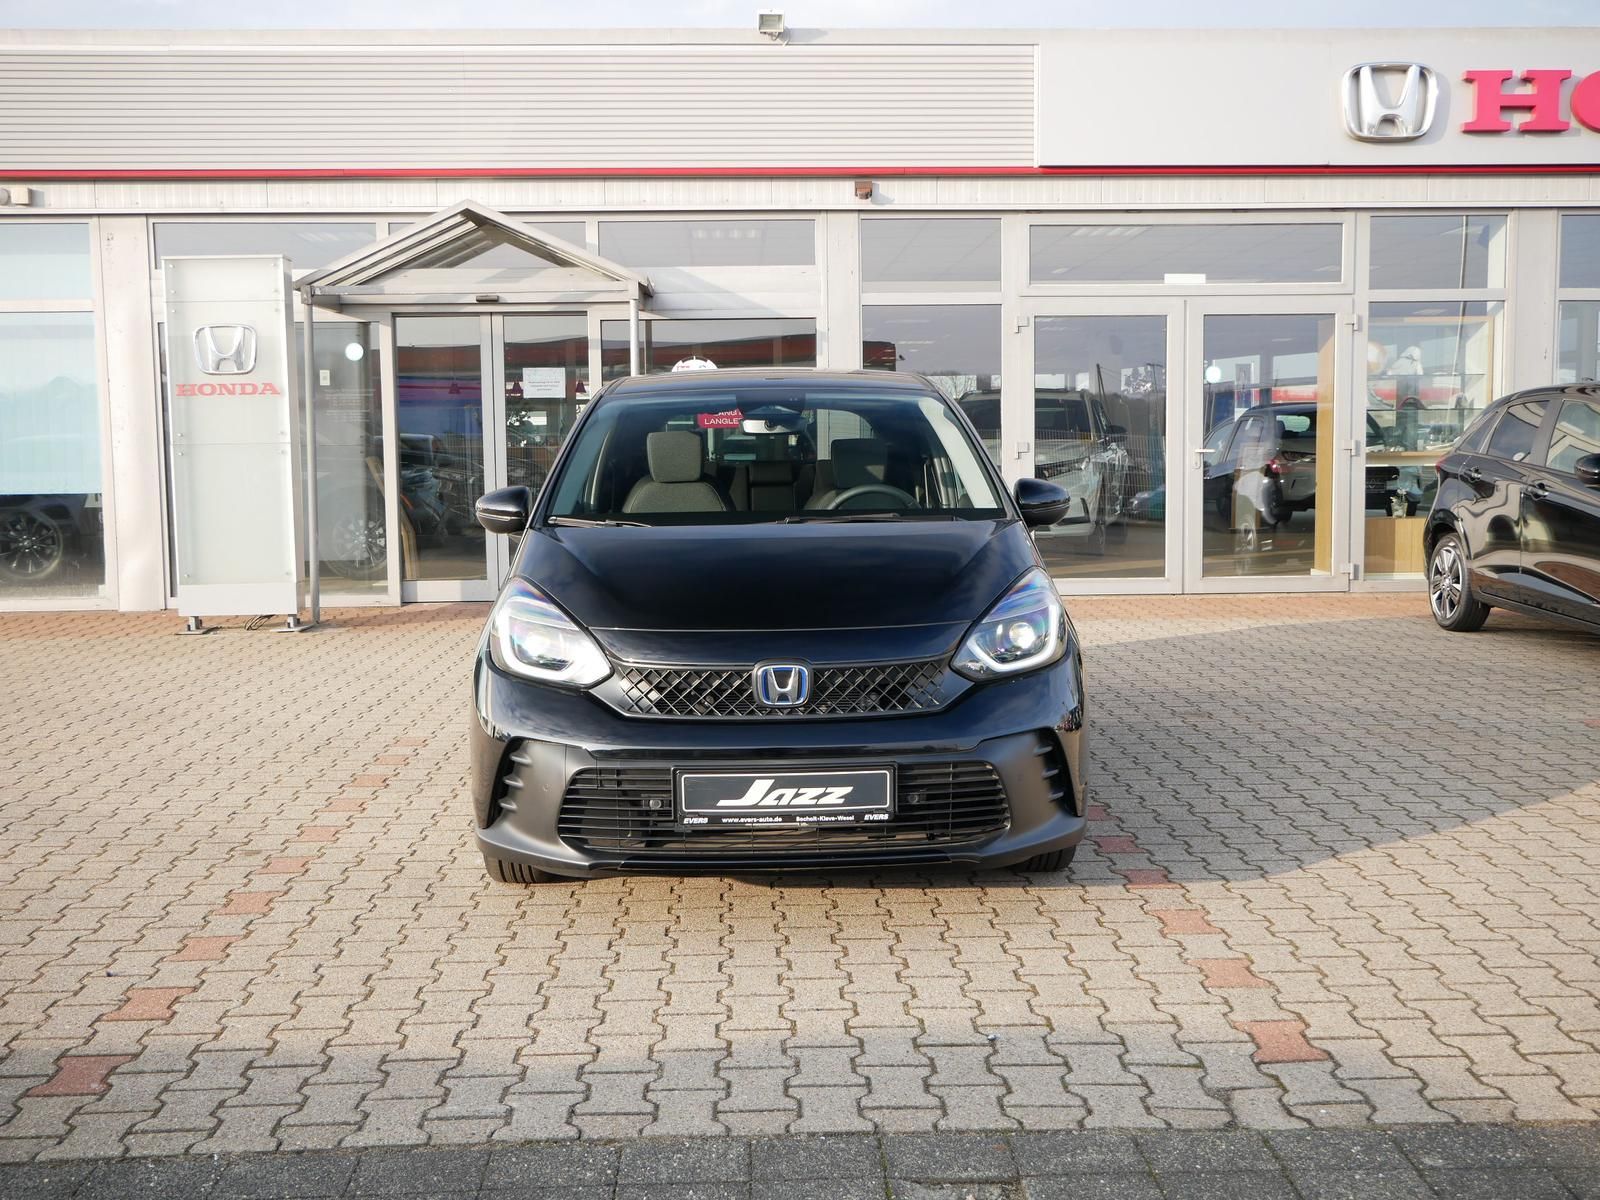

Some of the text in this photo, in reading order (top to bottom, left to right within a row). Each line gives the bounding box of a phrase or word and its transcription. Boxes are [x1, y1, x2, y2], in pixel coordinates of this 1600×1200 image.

[176, 382, 281, 397] HONDA
[683, 816, 709, 824] EVERS
[721, 815, 783, 824] www.evers-auto.de
[863, 813, 889, 821] EVERS
